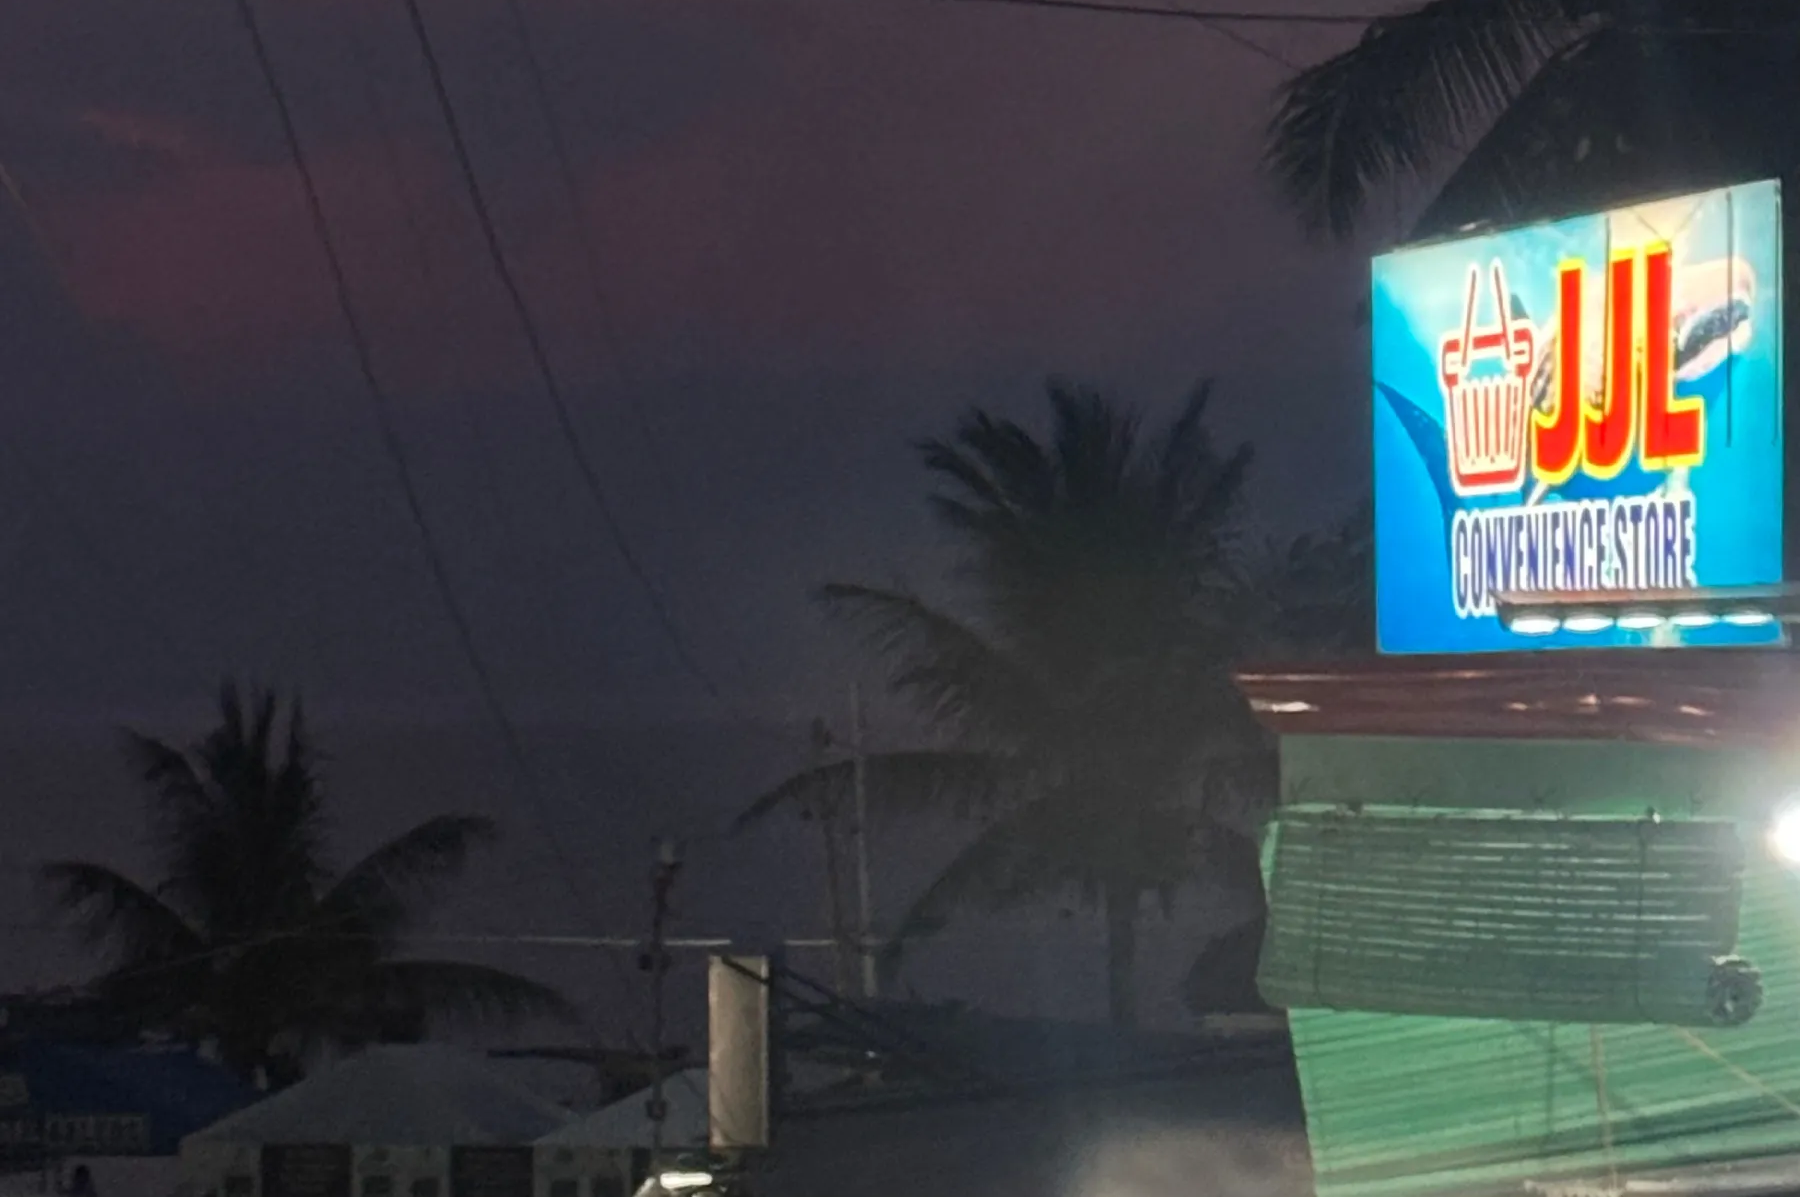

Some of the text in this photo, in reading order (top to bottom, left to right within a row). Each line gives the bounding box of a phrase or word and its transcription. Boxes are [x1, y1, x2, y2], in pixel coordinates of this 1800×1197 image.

[1531, 240, 1704, 484] JJL
[1453, 493, 1695, 616] CONVENIENCE STORE
